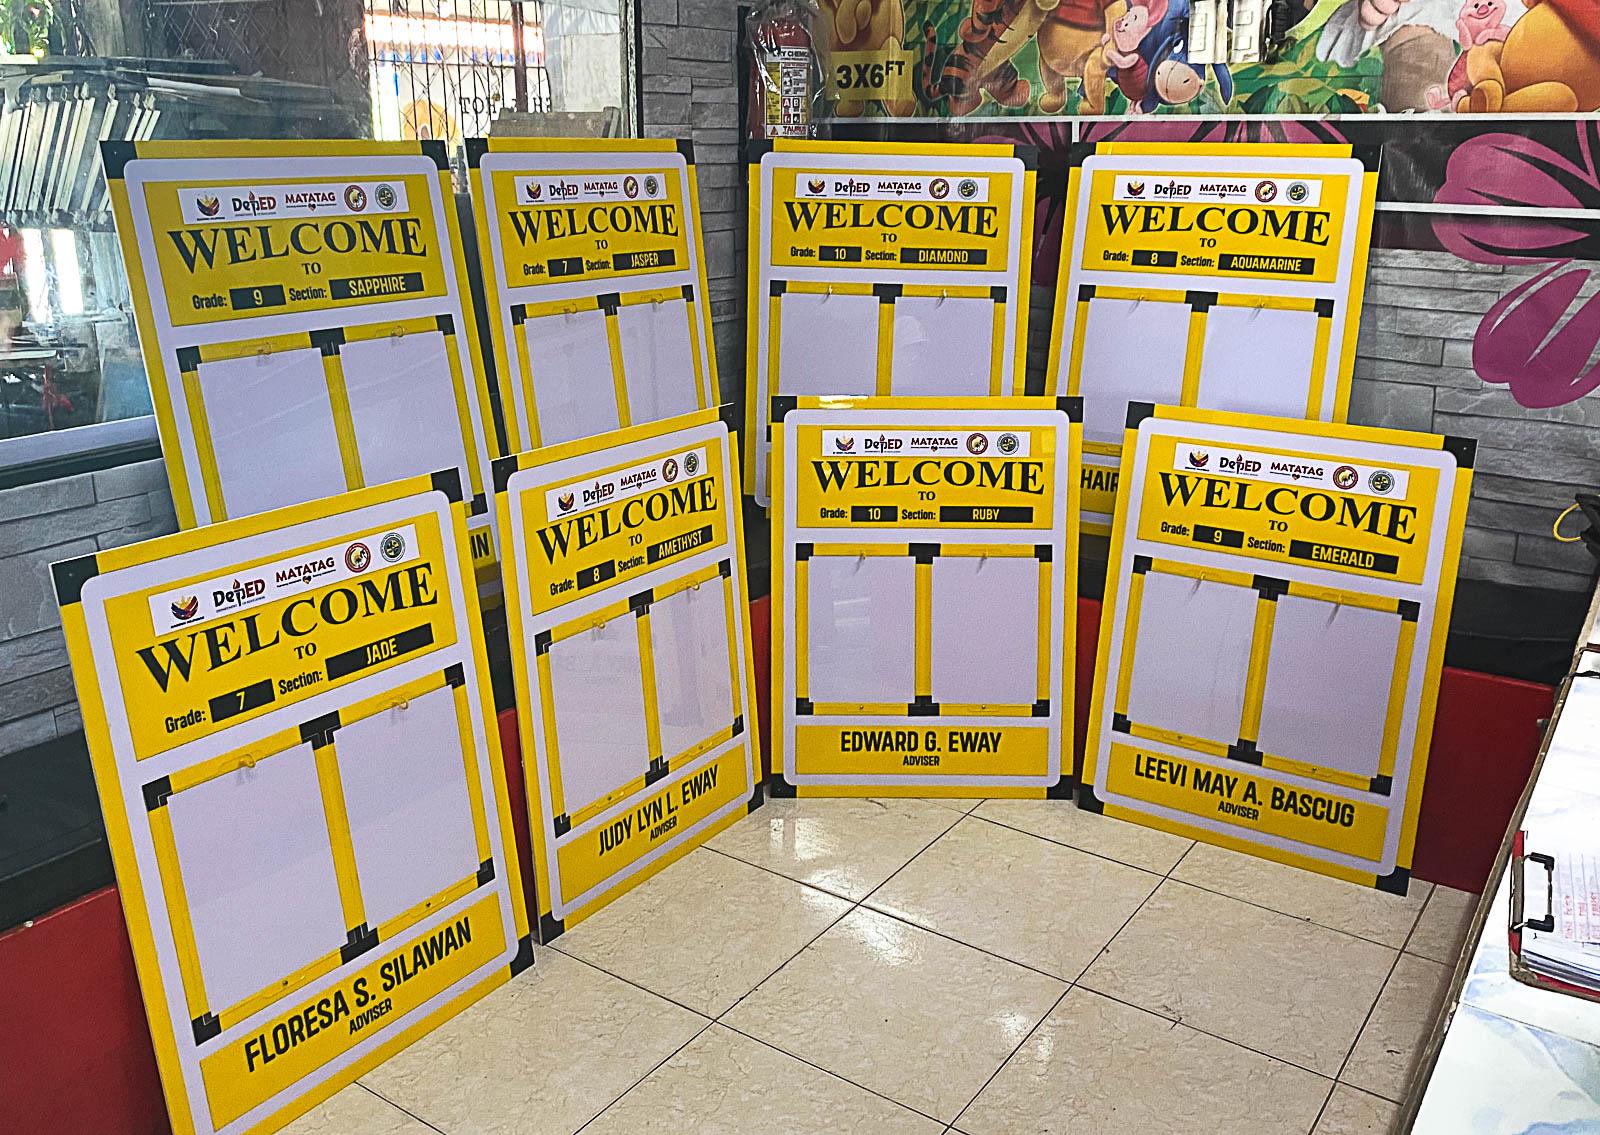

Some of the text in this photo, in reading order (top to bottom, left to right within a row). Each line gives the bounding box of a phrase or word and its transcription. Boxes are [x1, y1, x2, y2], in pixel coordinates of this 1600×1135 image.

[584, 182, 618, 192] MATATAG
[877, 181, 922, 191] MATATAG
[1199, 183, 1247, 193] MATATAG
[285, 191, 337, 205] MATATAG
[508, 204, 679, 247] WELCOME
[784, 201, 998, 238] WELCOME
[1101, 204, 1331, 247] WELCOME
[167, 218, 427, 274] WELCOME
[594, 239, 608, 250] TO
[881, 232, 898, 243] TO
[1199, 237, 1217, 248] TO
[523, 252, 659, 276] Grade: 7 Section: JASPER
[790, 246, 969, 263] Grade: 10 Section: DIAMOND
[1103, 250, 1302, 272] Grade: 8 Section: AQUAMARINE
[301, 262, 322, 275] TO
[192, 275, 406, 310] Grade: 9 Section: SAPPHIRE
[911, 437, 958, 446] MATATAG
[620, 468, 657, 487] MATATAG
[811, 460, 1045, 495] WELCOME
[1270, 462, 1324, 477] MATATAG
[917, 490, 936, 501] TO
[820, 507, 1000, 521] Grade: 10 Section: RUBY
[1159, 472, 1417, 545] WELCOME
[536, 477, 717, 566] WELCOME
[1269, 519, 1288, 532] TO
[629, 533, 643, 547] TO
[1160, 521, 1374, 568] Grade: 9 Section: EMERALD
[275, 557, 335, 582] MATATAG
[550, 530, 702, 596] Grade: 8 Section: AMETHYST
[135, 562, 438, 693] WELCOME
[293, 642, 317, 660] TO
[165, 638, 398, 734] Grade: 7 Section: JADE
[841, 731, 1002, 753] EDWARD G. EWAY
[902, 755, 940, 766] ADVISER
[1135, 754, 1355, 827] LEEVI MAY A. BASCUG
[599, 764, 718, 856] JUDY LYN L. EWAY
[1217, 801, 1260, 821] ADVISER
[650, 815, 677, 841] ADVISER
[244, 916, 472, 1073] FLORESA S. SILAWAN
[349, 998, 393, 1035] ADVISER
